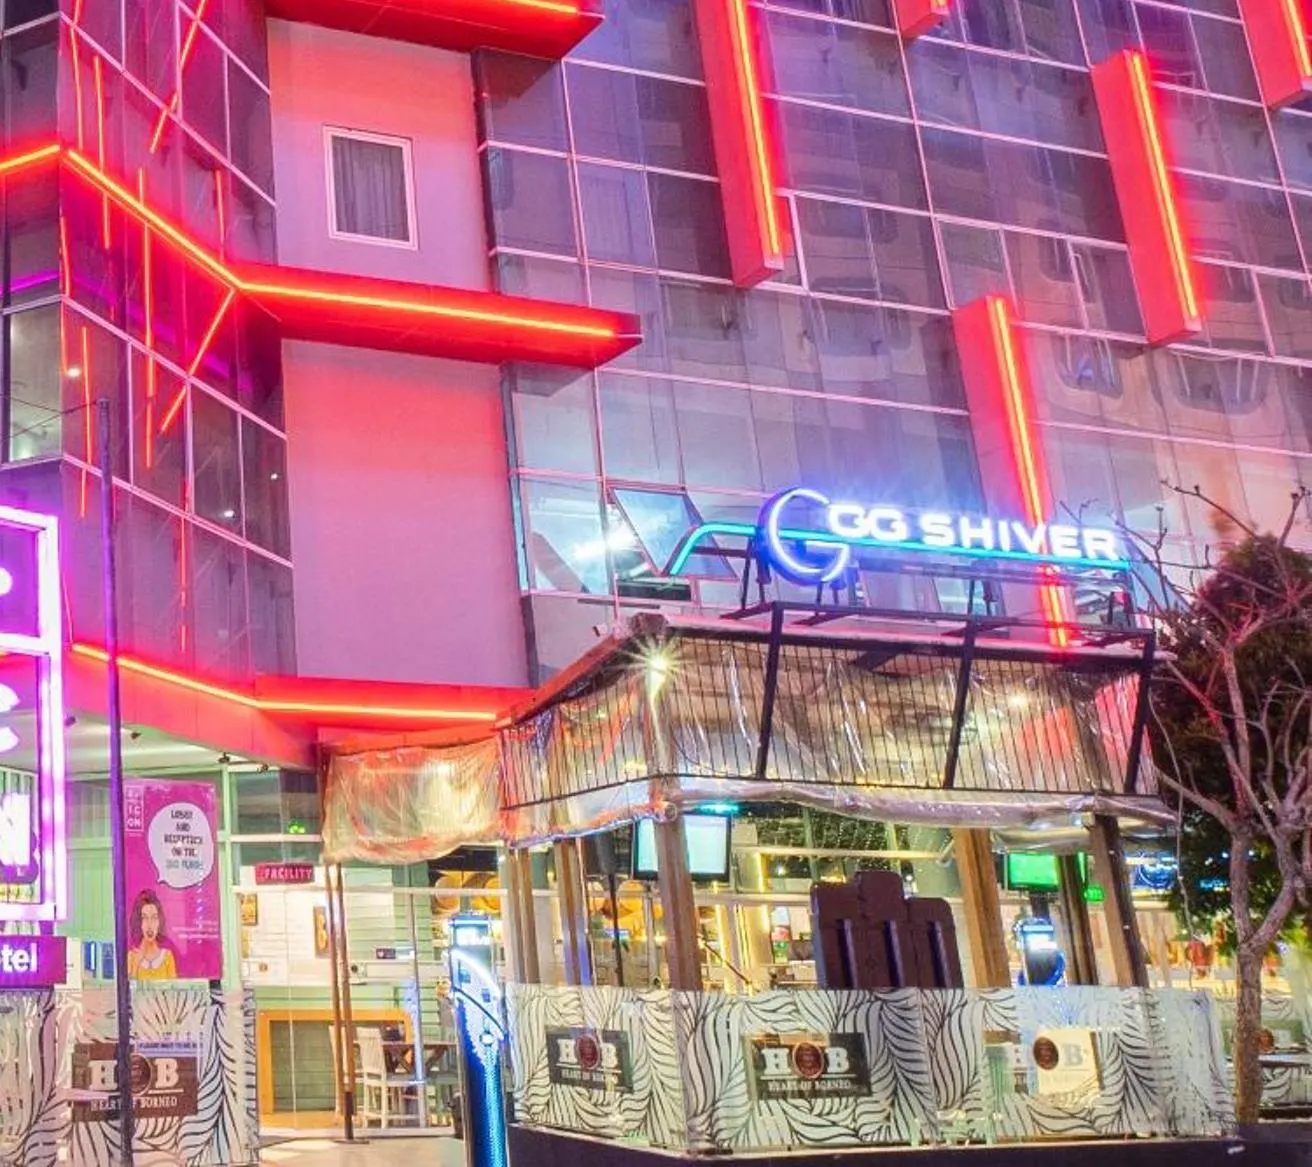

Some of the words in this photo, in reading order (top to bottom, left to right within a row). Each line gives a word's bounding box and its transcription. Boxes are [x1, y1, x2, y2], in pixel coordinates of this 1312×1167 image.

[827, 503, 908, 542] GG
[919, 511, 1121, 560] SHIVER
[264, 867, 313, 880] FACILITY
[139, 1096, 178, 1109] BORNEO
